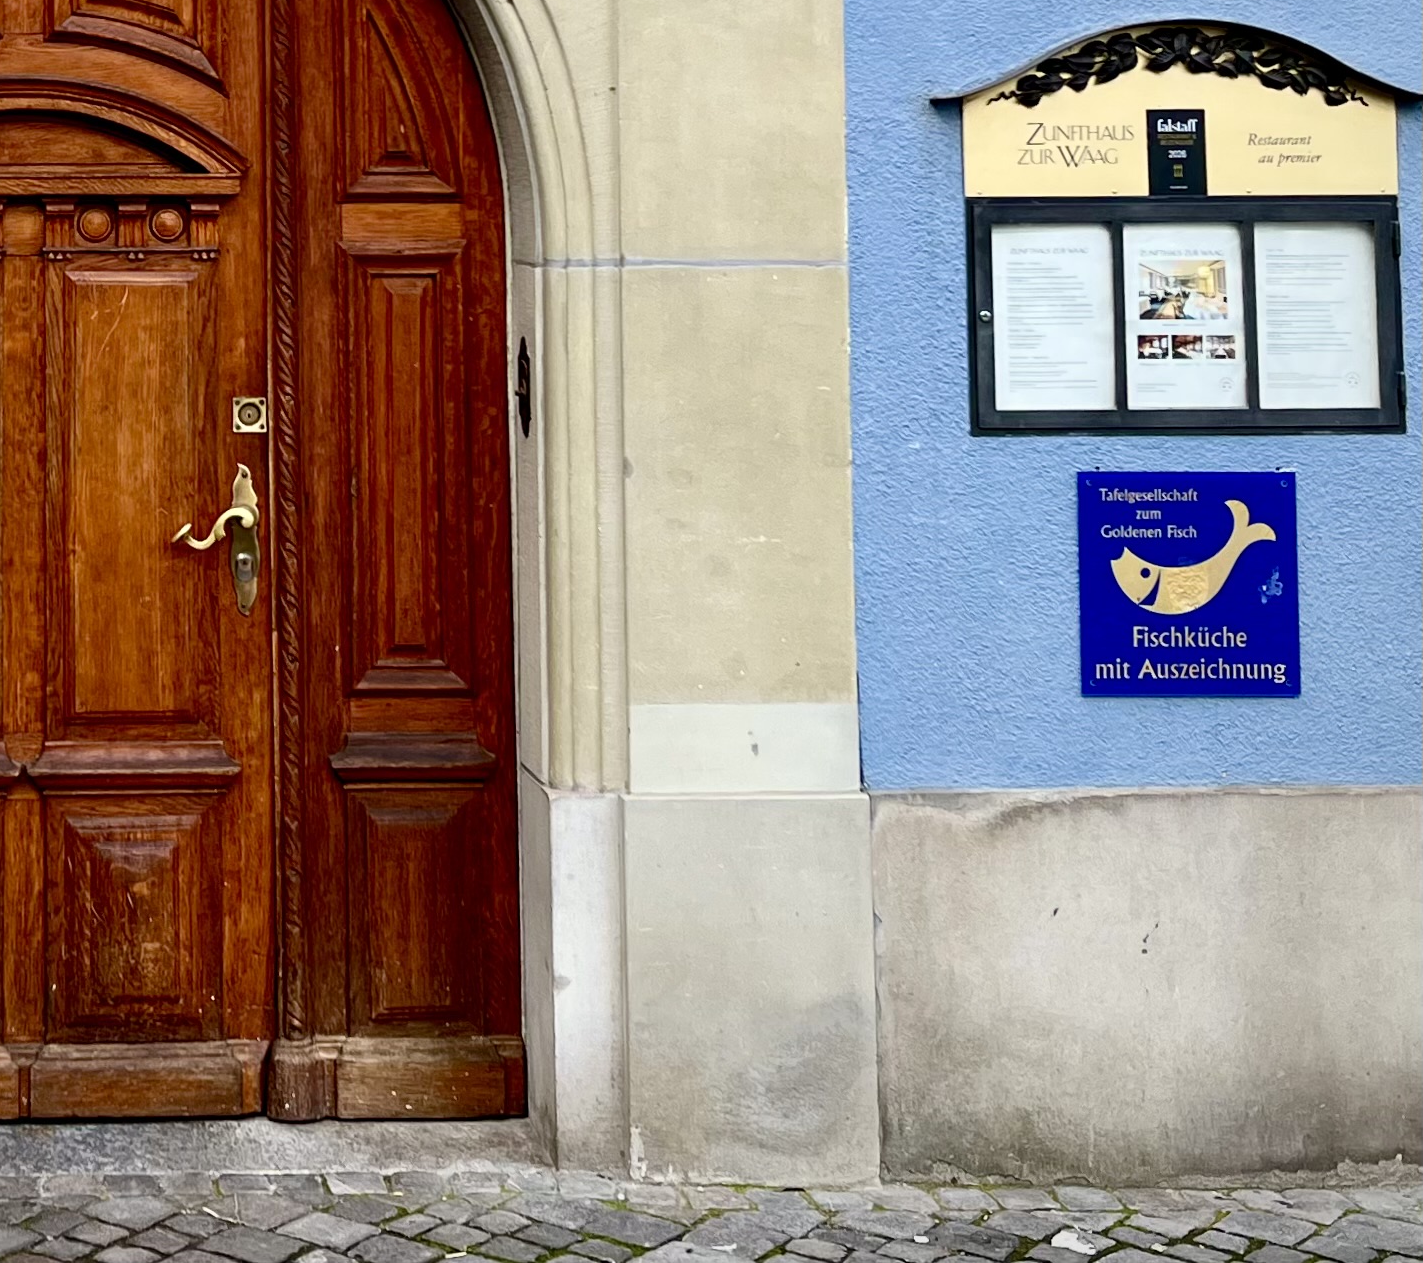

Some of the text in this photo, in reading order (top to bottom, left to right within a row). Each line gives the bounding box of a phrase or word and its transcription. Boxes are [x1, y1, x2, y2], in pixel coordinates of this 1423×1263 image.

[1026, 122, 1135, 145] ZUNFTHAUS
[1248, 133, 1312, 145] Restaurant
[1017, 145, 1119, 168] ZUR WAAG
[1258, 151, 1322, 167] au premier
[1099, 488, 1198, 504] Tafelgesellschaft
[1136, 510, 1162, 520] zum
[1100, 524, 1197, 538] Goldenen Fisch
[1133, 625, 1248, 648] Fischküche
[1095, 658, 1287, 683] mit Auszeichnung
